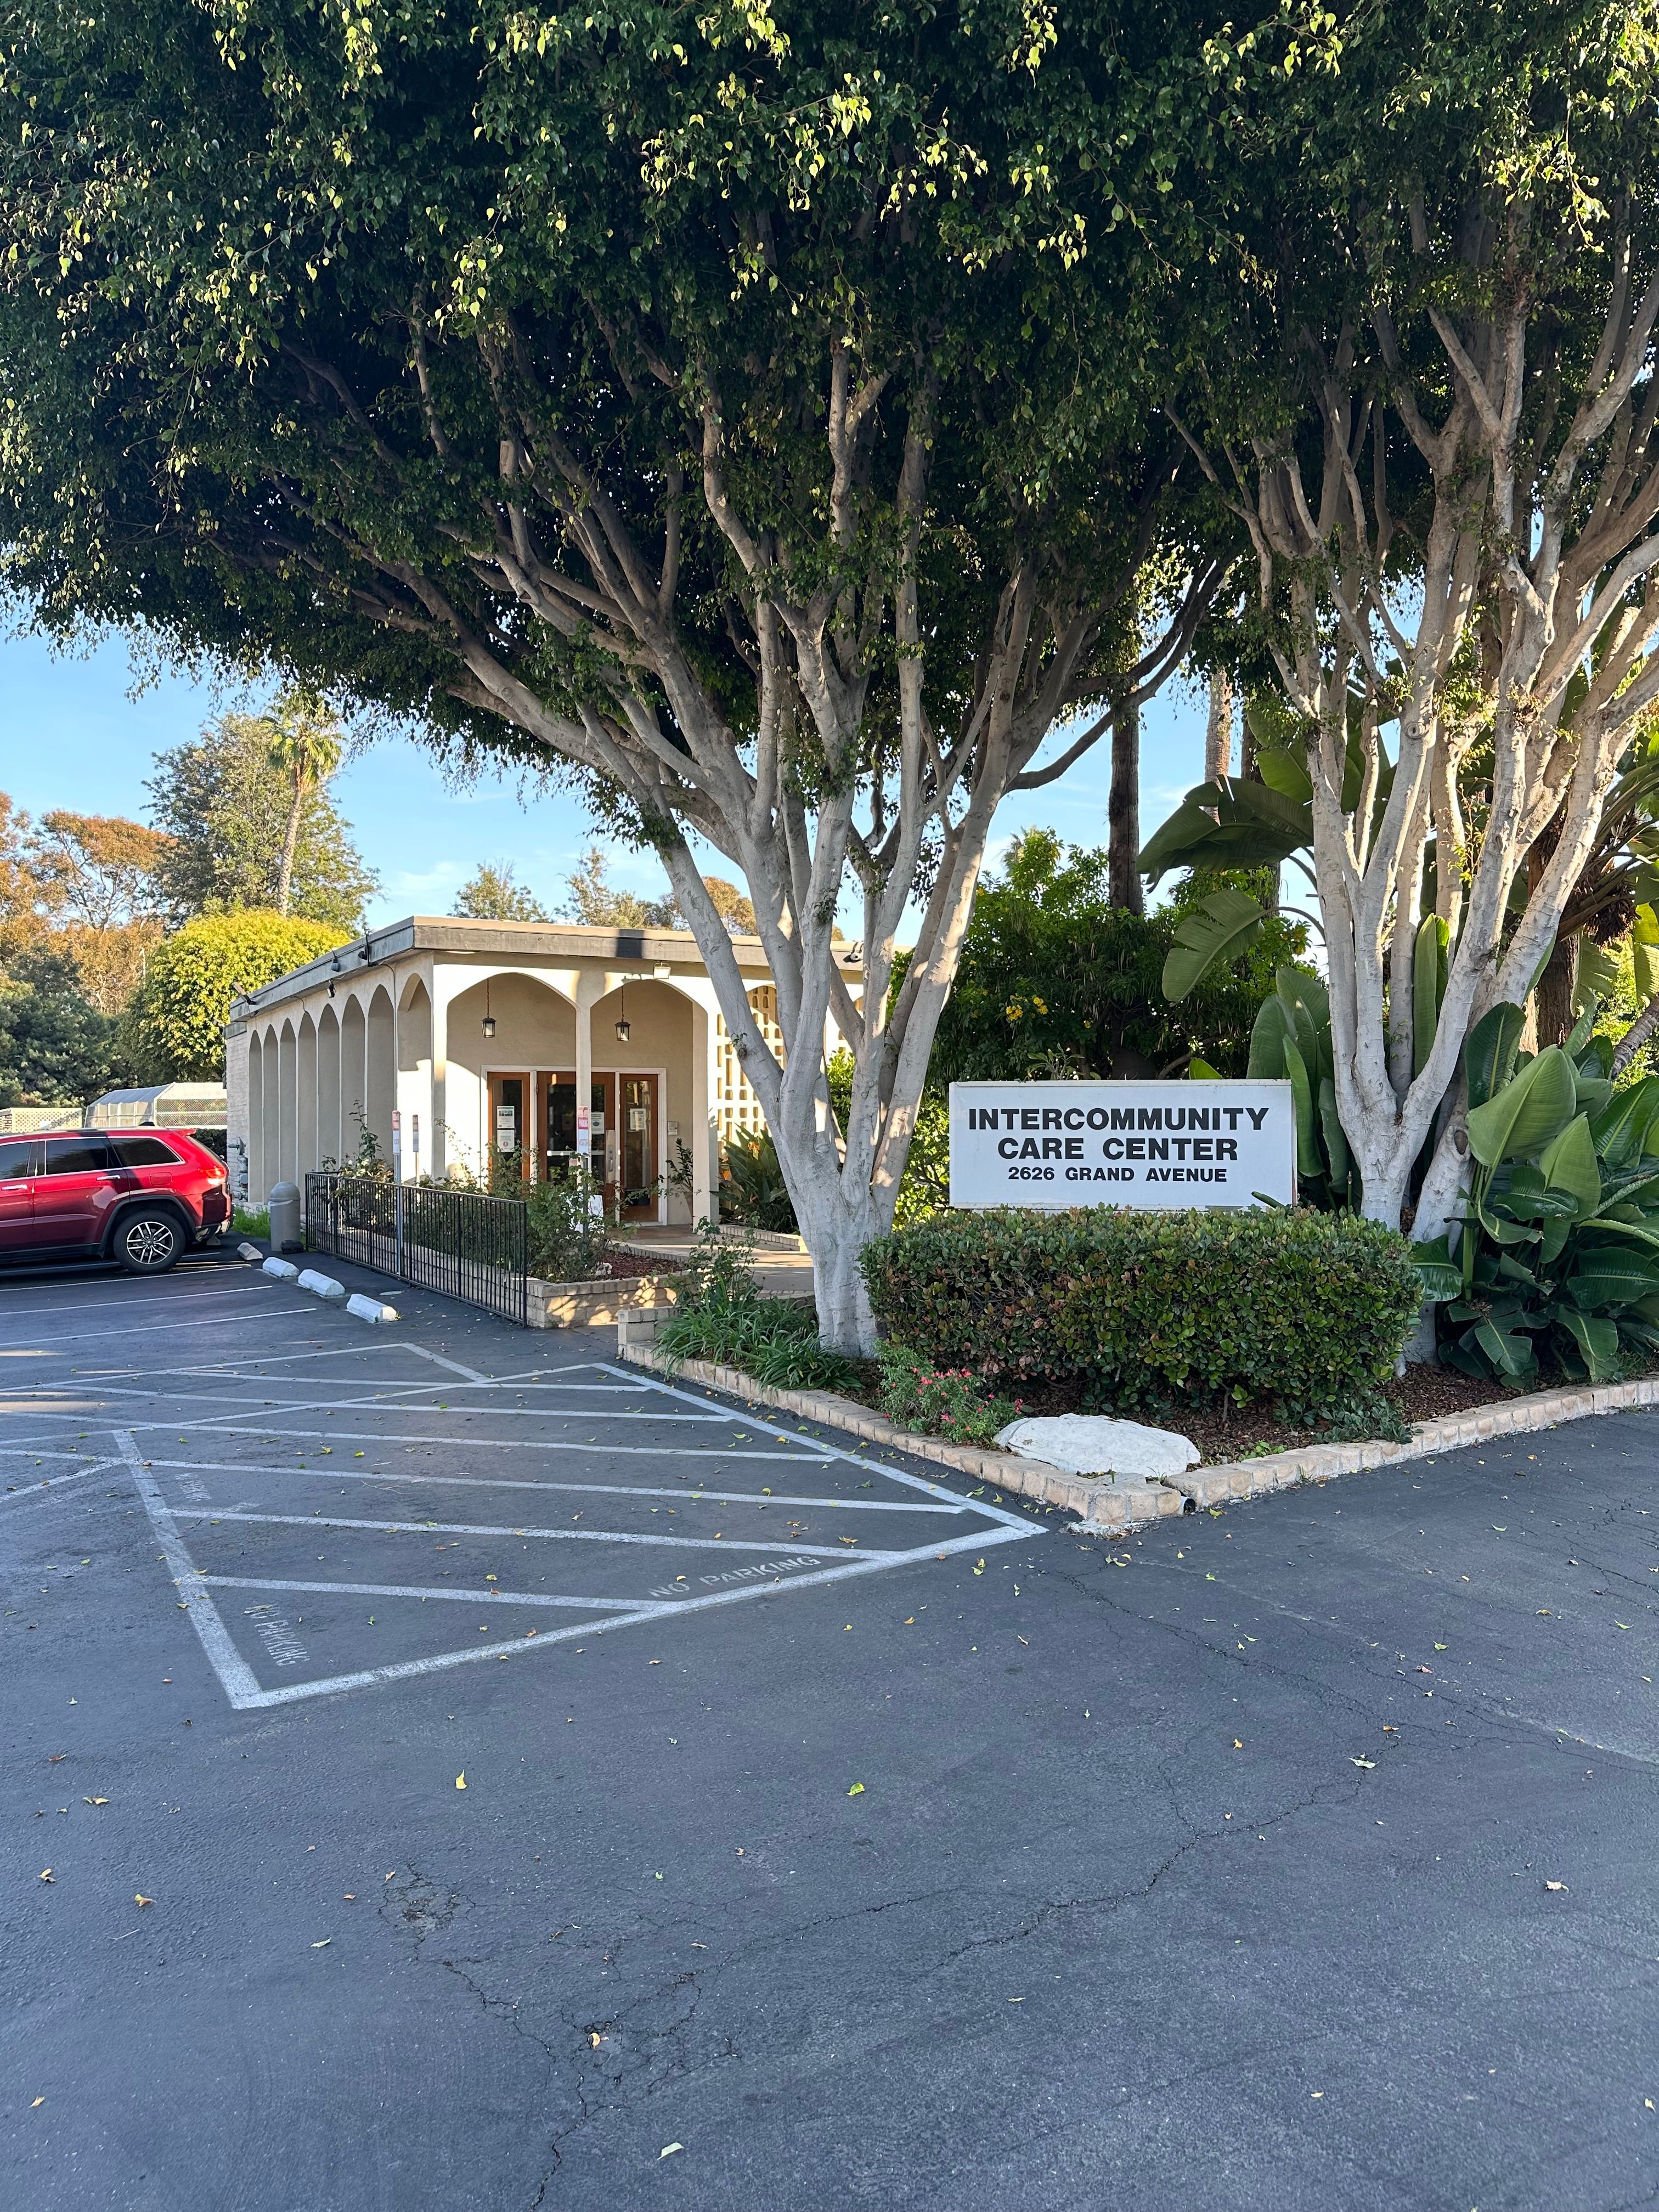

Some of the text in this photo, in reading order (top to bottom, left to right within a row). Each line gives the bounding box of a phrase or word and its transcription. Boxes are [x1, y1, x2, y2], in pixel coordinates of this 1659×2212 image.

[969, 1108, 1268, 1130] INTERCOMMUNITY
[998, 1138, 1237, 1160] CARE CENTER
[1008, 1167, 1227, 1182] 2626 GRAND AVENUE
[647, 1556, 821, 1598] NO PARKING
[254, 1620, 311, 1666] PARKING
